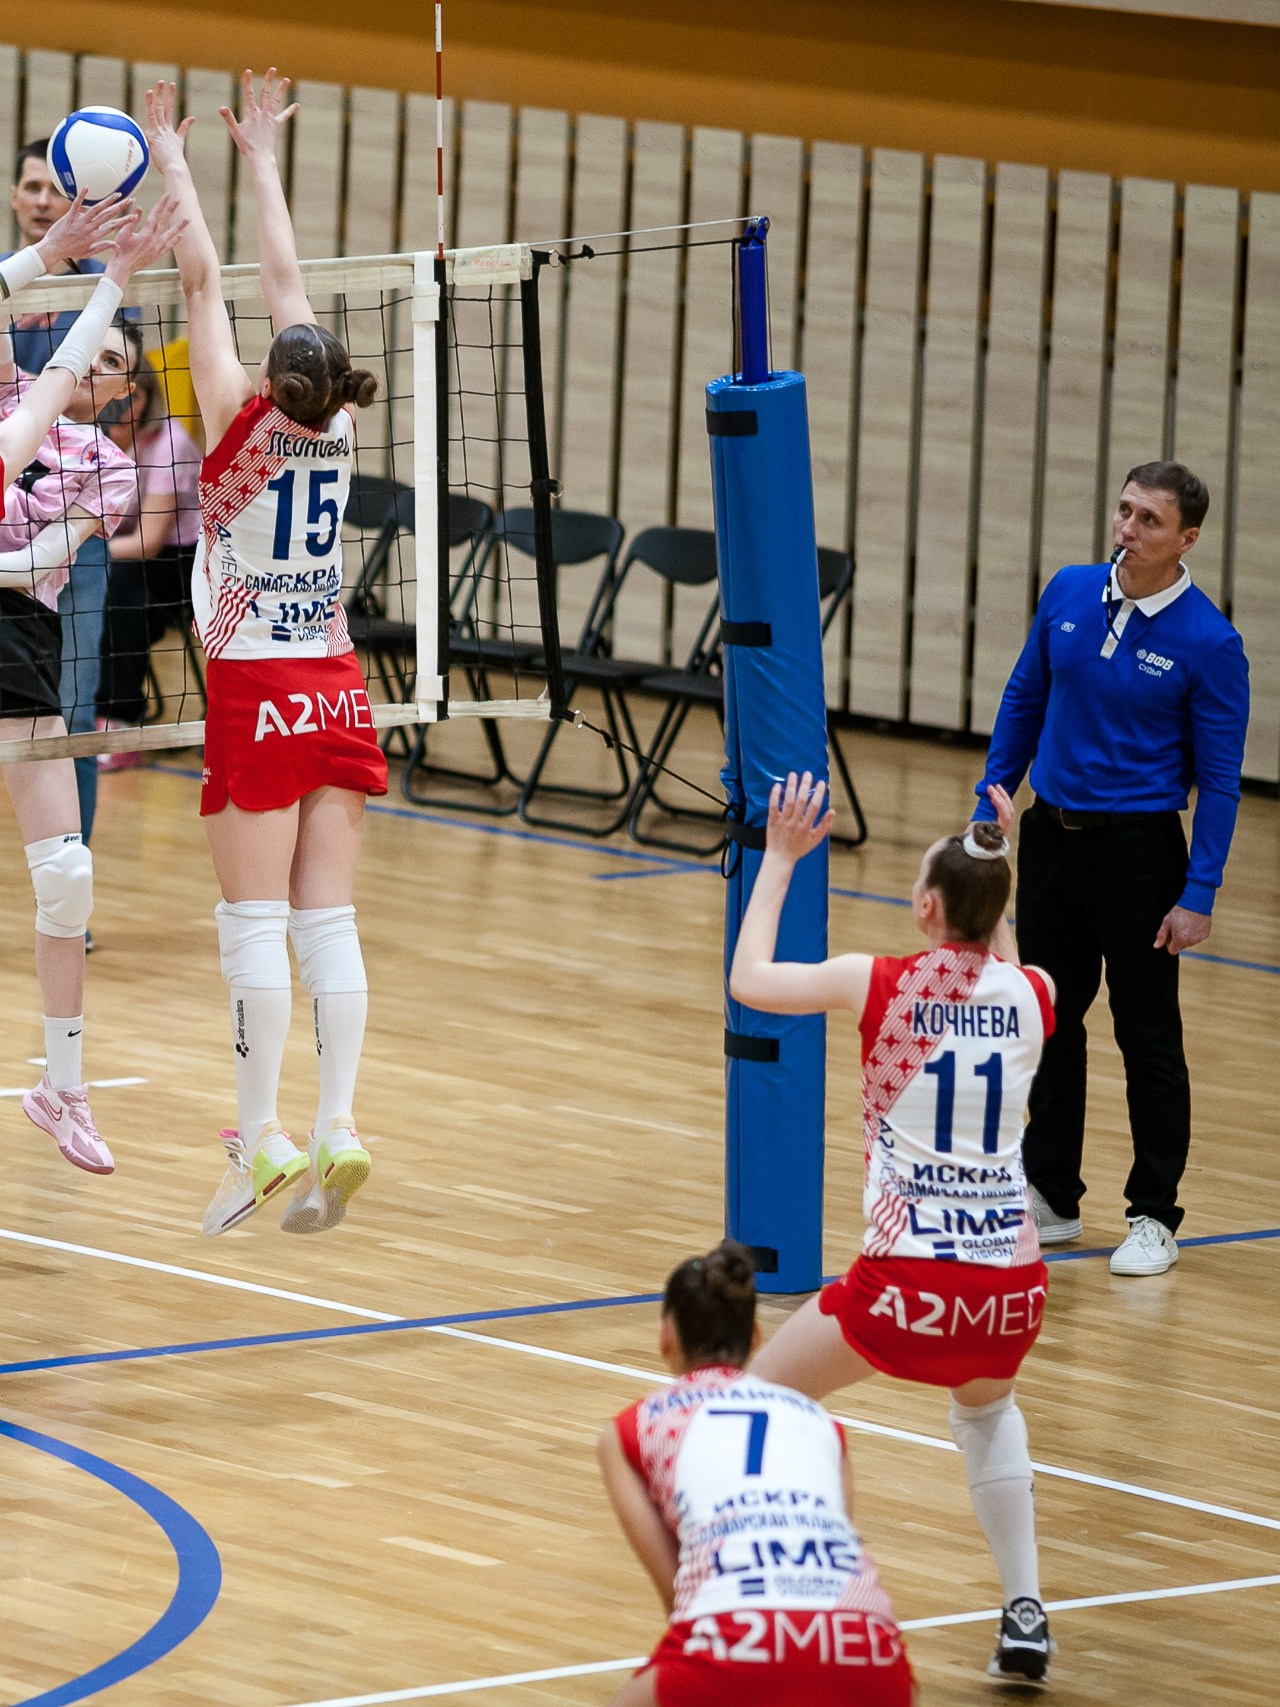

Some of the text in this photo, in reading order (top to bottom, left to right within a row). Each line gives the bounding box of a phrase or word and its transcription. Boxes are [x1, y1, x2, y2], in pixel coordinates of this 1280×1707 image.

[265, 430, 350, 458] ЛЕОНОВА
[267, 469, 339, 560] 15
[1145, 652, 1174, 671] ВФВ
[254, 689, 376, 742] A2ME
[913, 1002, 1020, 1038] КОЧНЕВА
[924, 1050, 1003, 1154] 11
[913, 1163, 1012, 1184] ИСКРА
[907, 1201, 1025, 1236] LIME
[962, 1236, 1017, 1249] GLOBAL
[964, 1247, 1013, 1260] VISION
[869, 1285, 1046, 1337] A2MED
[706, 1409, 769, 1476] 7
[714, 1489, 827, 1513] ИСКРА
[713, 1538, 861, 1576] LIME
[682, 1610, 902, 1666] A2MED
